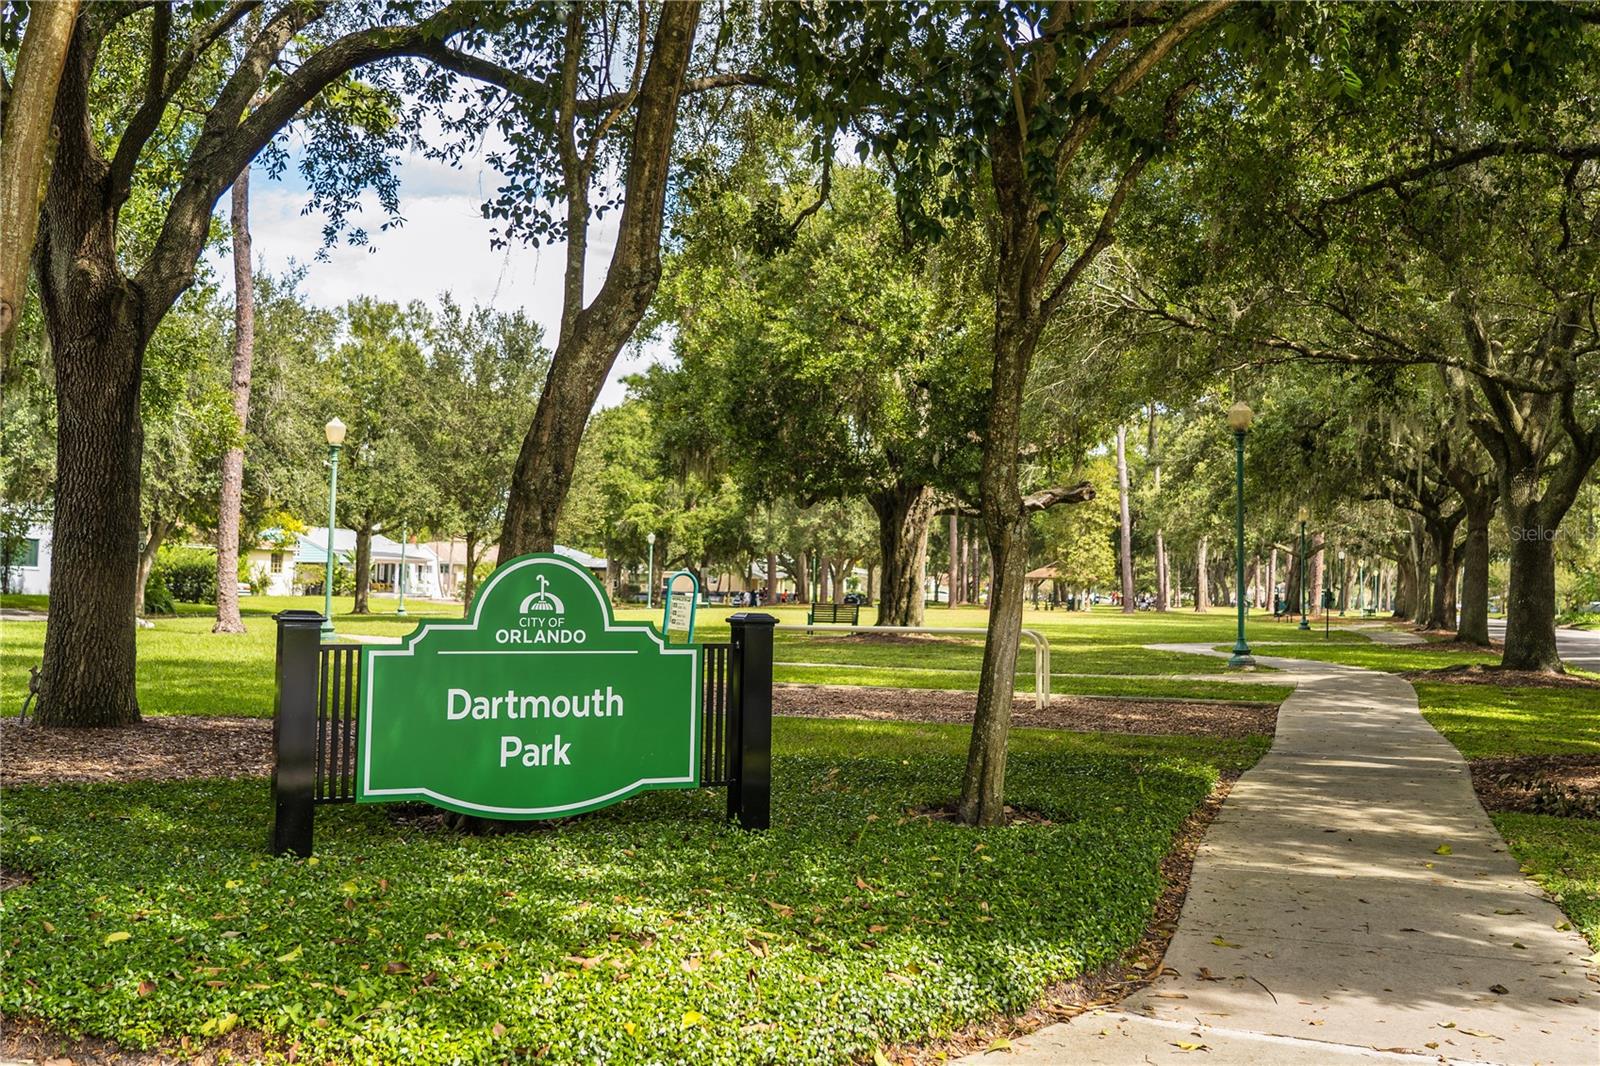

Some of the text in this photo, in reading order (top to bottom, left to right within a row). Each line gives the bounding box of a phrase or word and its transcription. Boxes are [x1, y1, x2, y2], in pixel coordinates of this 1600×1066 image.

[519, 617, 565, 628] CITY OF
[495, 629, 587, 644] ORLANDO
[447, 686, 624, 720] Dartmouth
[500, 734, 572, 768] Park
